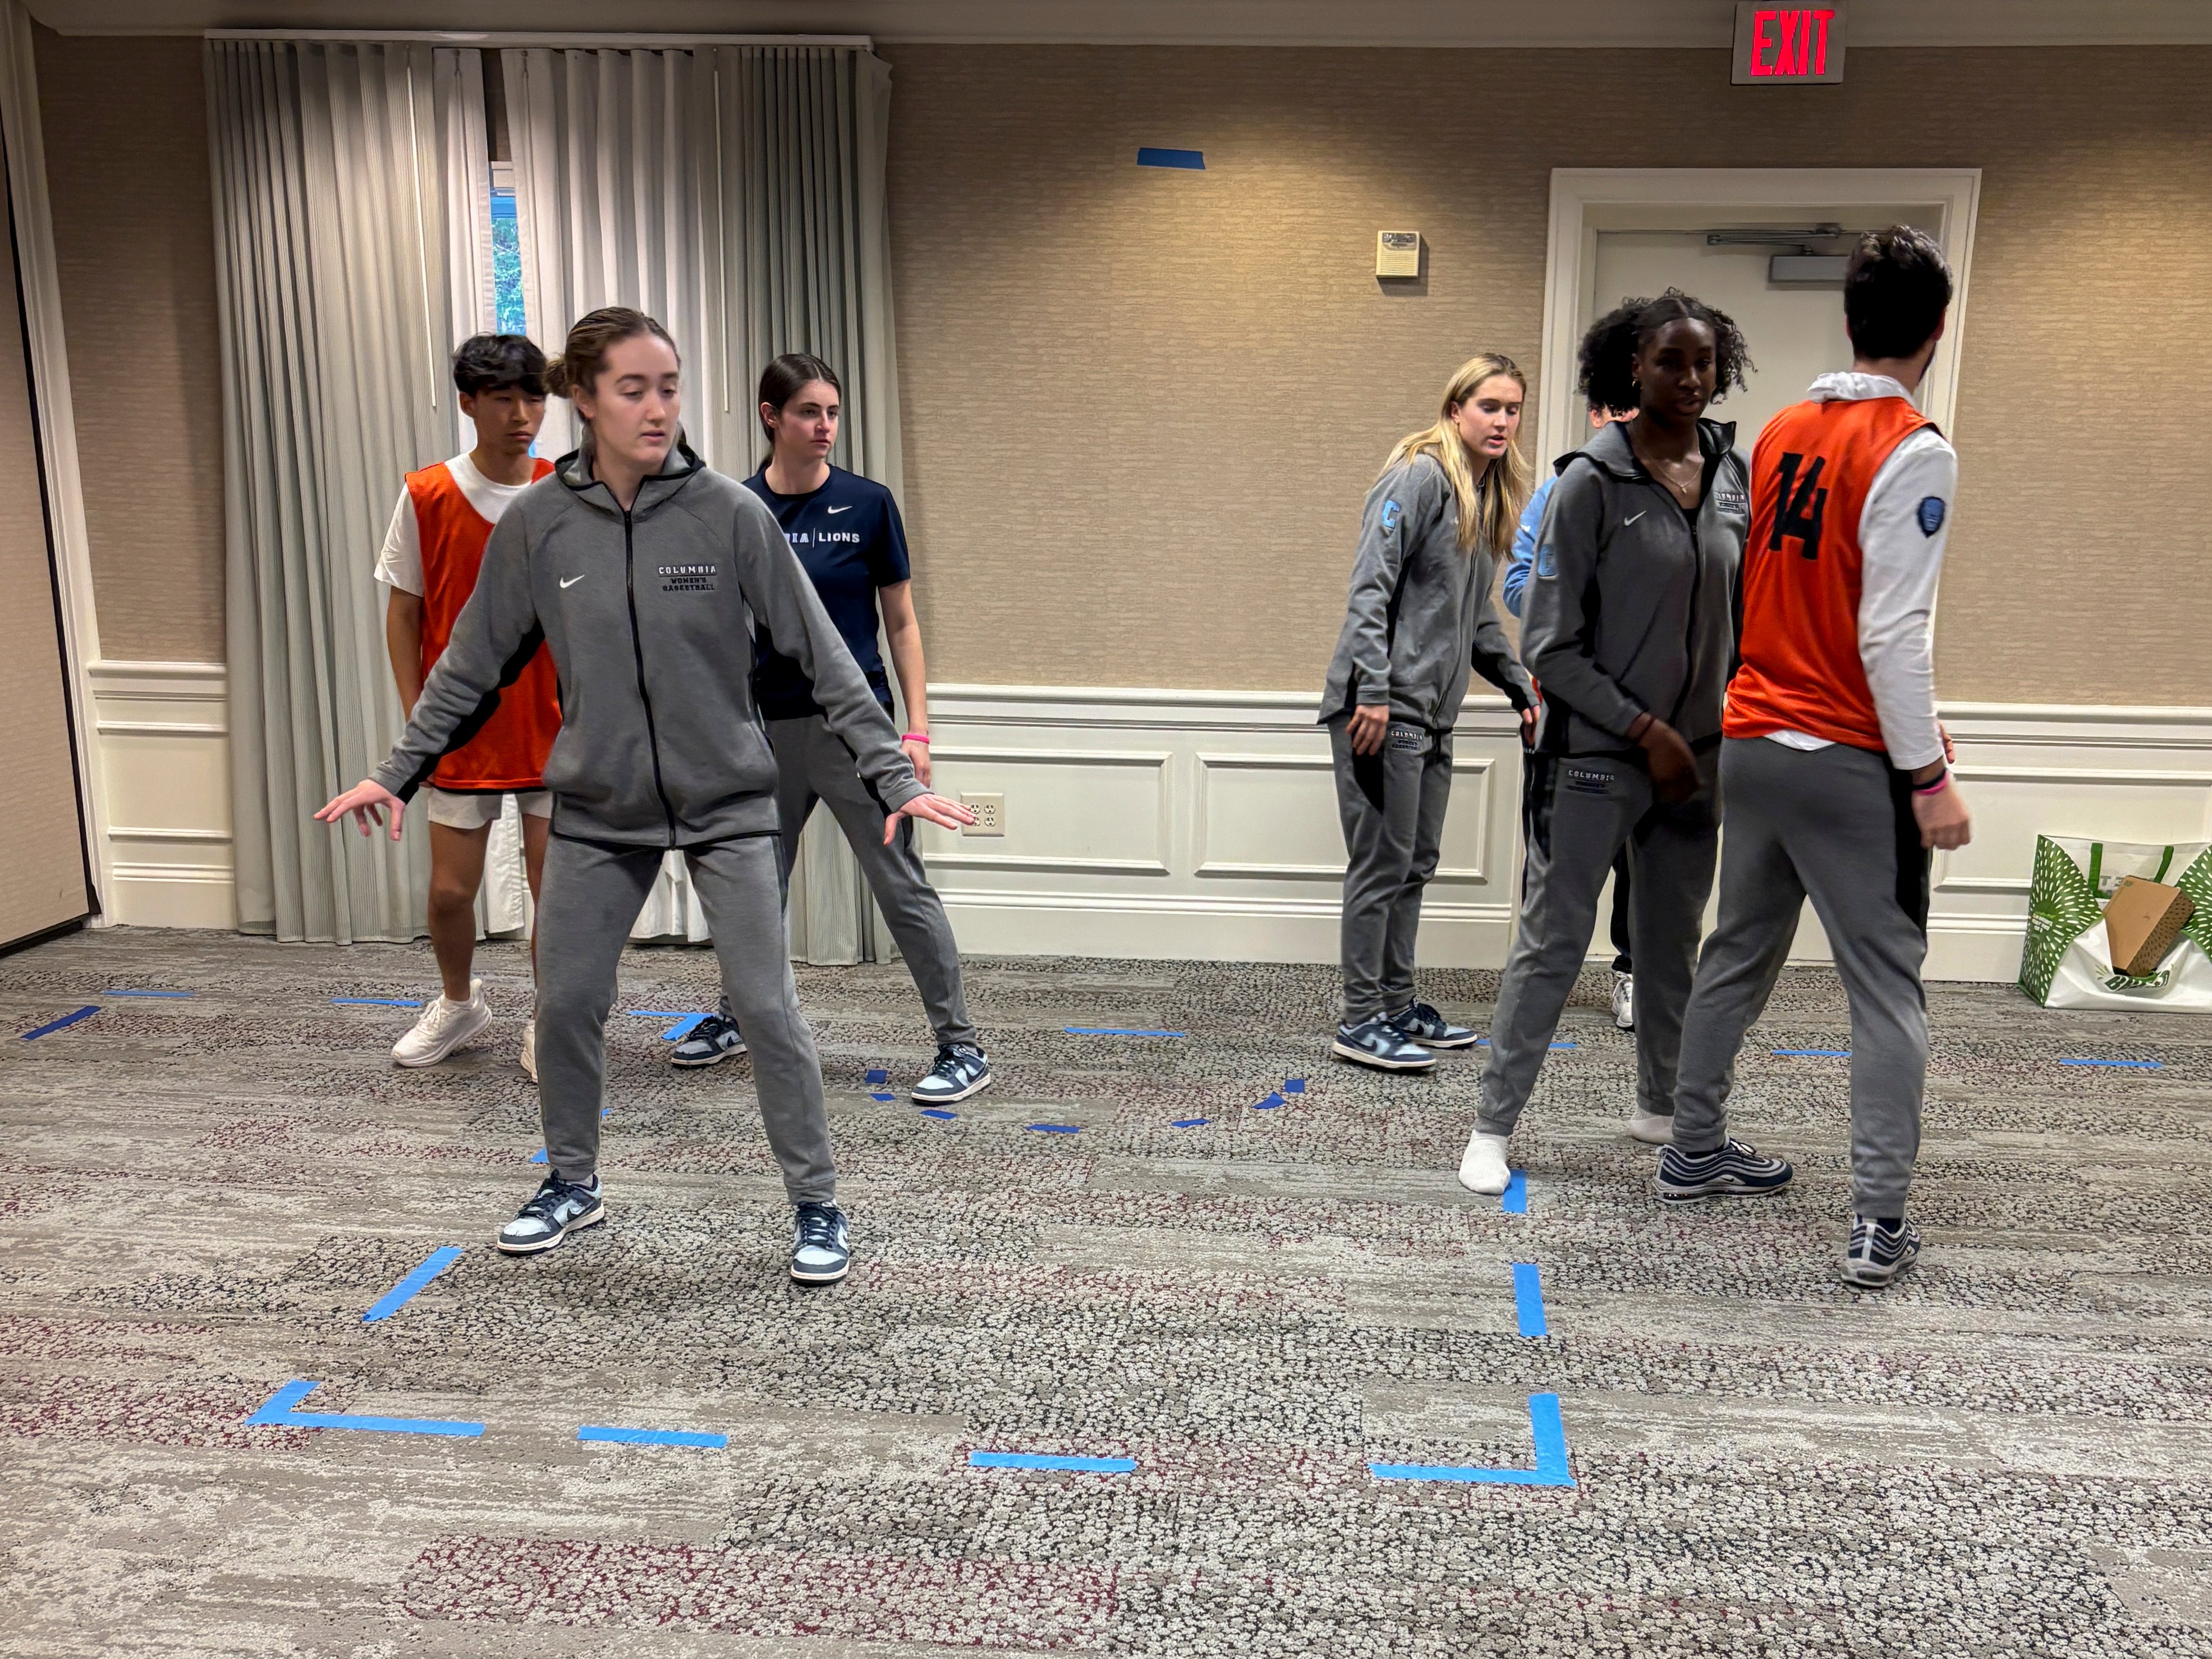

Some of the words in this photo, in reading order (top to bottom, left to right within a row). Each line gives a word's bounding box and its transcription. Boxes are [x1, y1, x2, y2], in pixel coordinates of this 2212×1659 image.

[1751, 10, 1835, 76] EXIT
[1383, 499, 1400, 529] C
[1769, 452, 1828, 560] 14
[818, 533, 860, 543] LIONS
[658, 566, 716, 574] COLUMBIA
